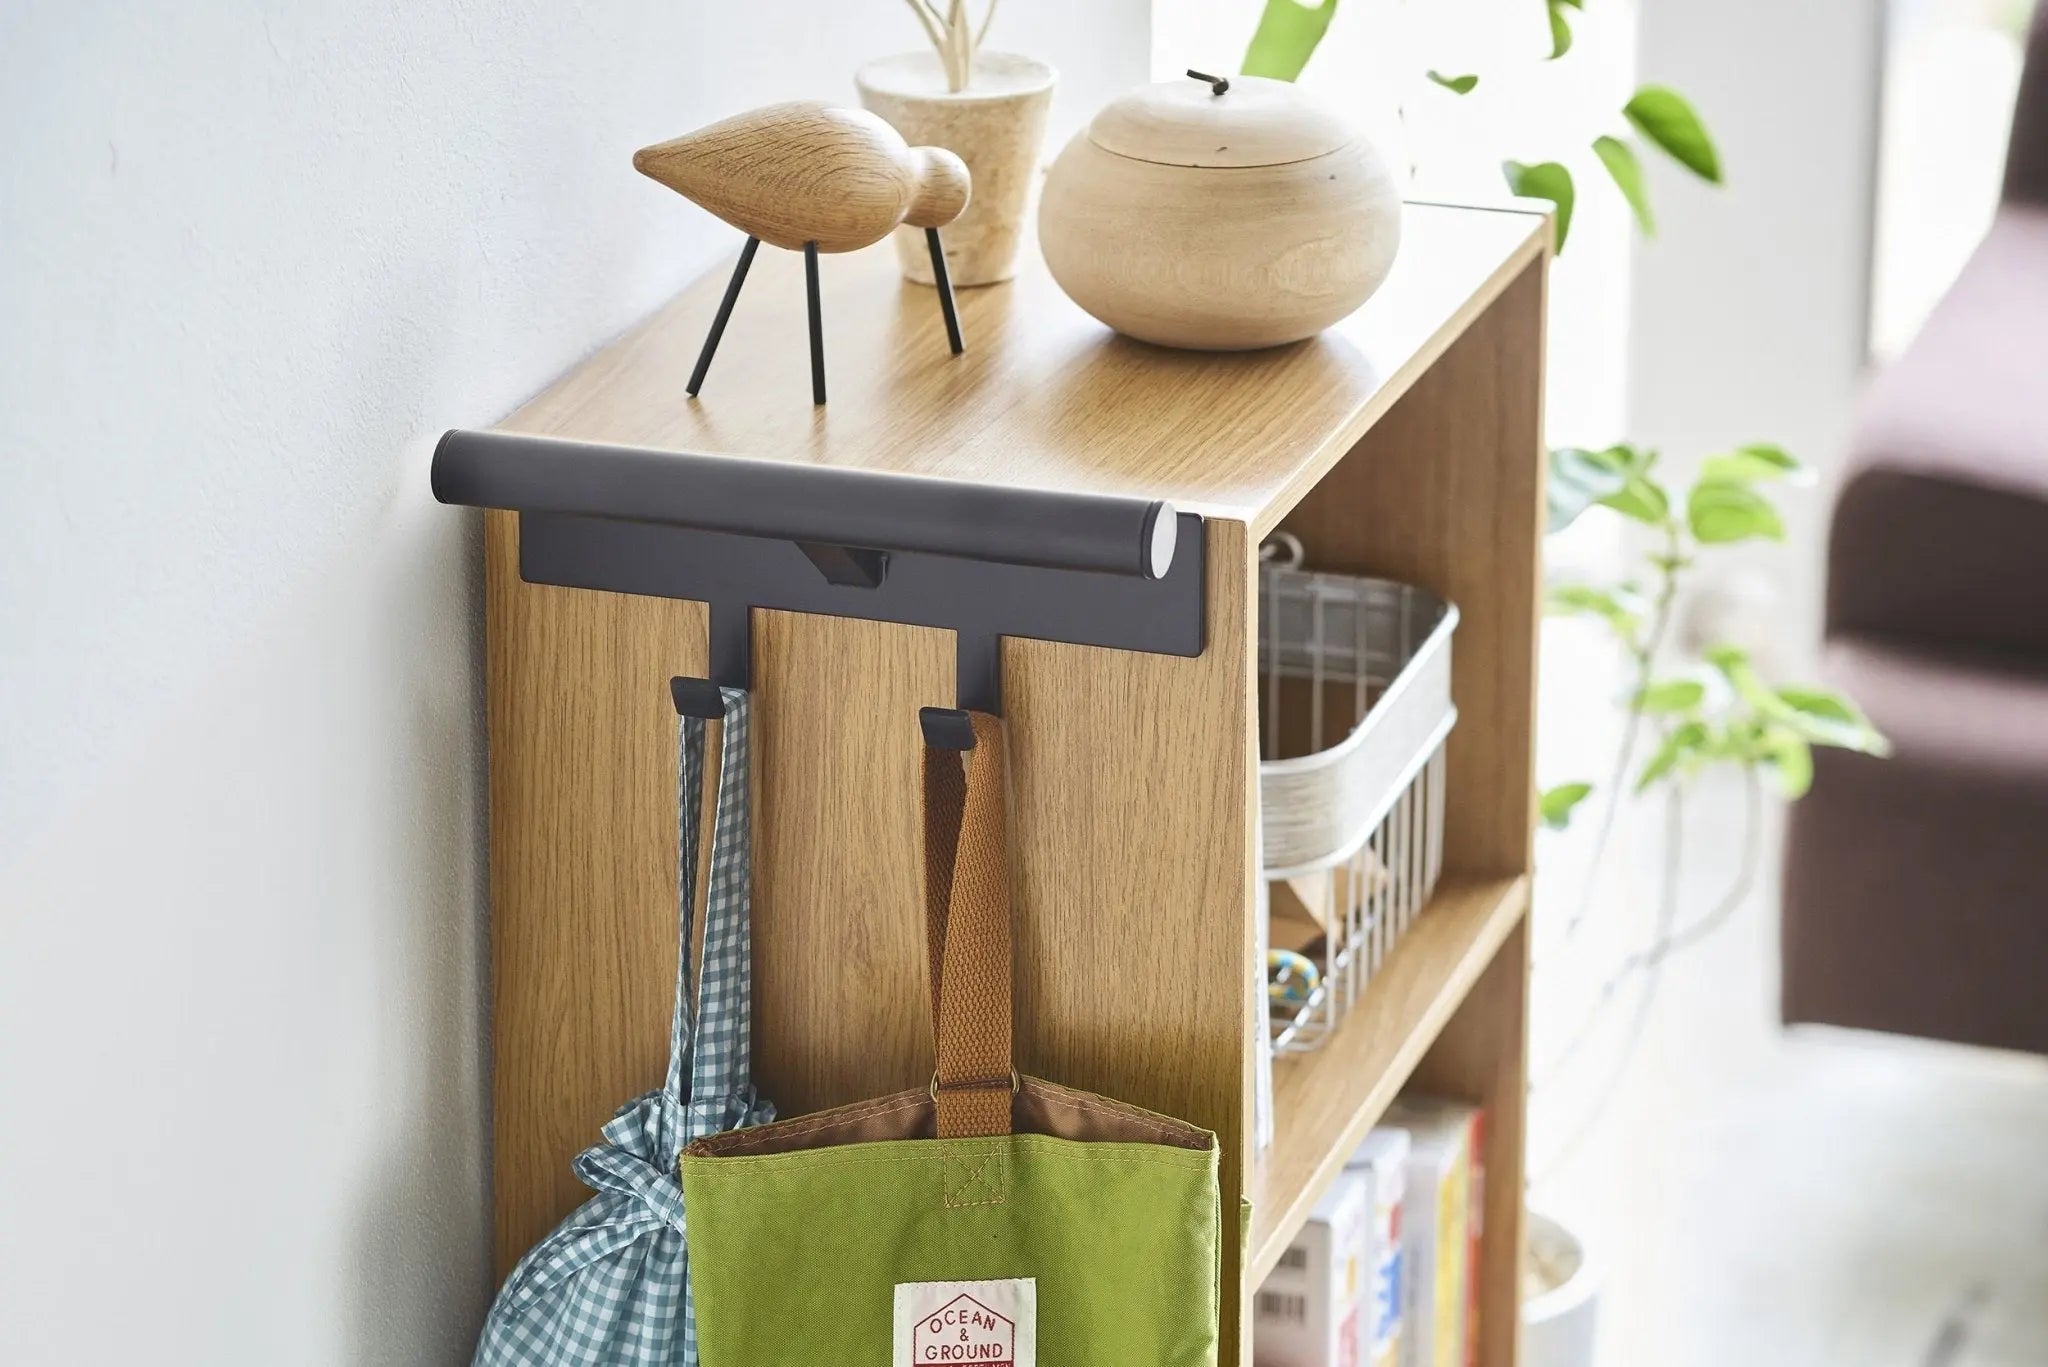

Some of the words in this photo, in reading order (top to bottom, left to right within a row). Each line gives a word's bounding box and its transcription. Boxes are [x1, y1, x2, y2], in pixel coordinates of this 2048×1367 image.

[930, 1310, 996, 1333] OCEAN
[960, 1328, 969, 1342] &
[925, 1343, 1003, 1360] GROUND
